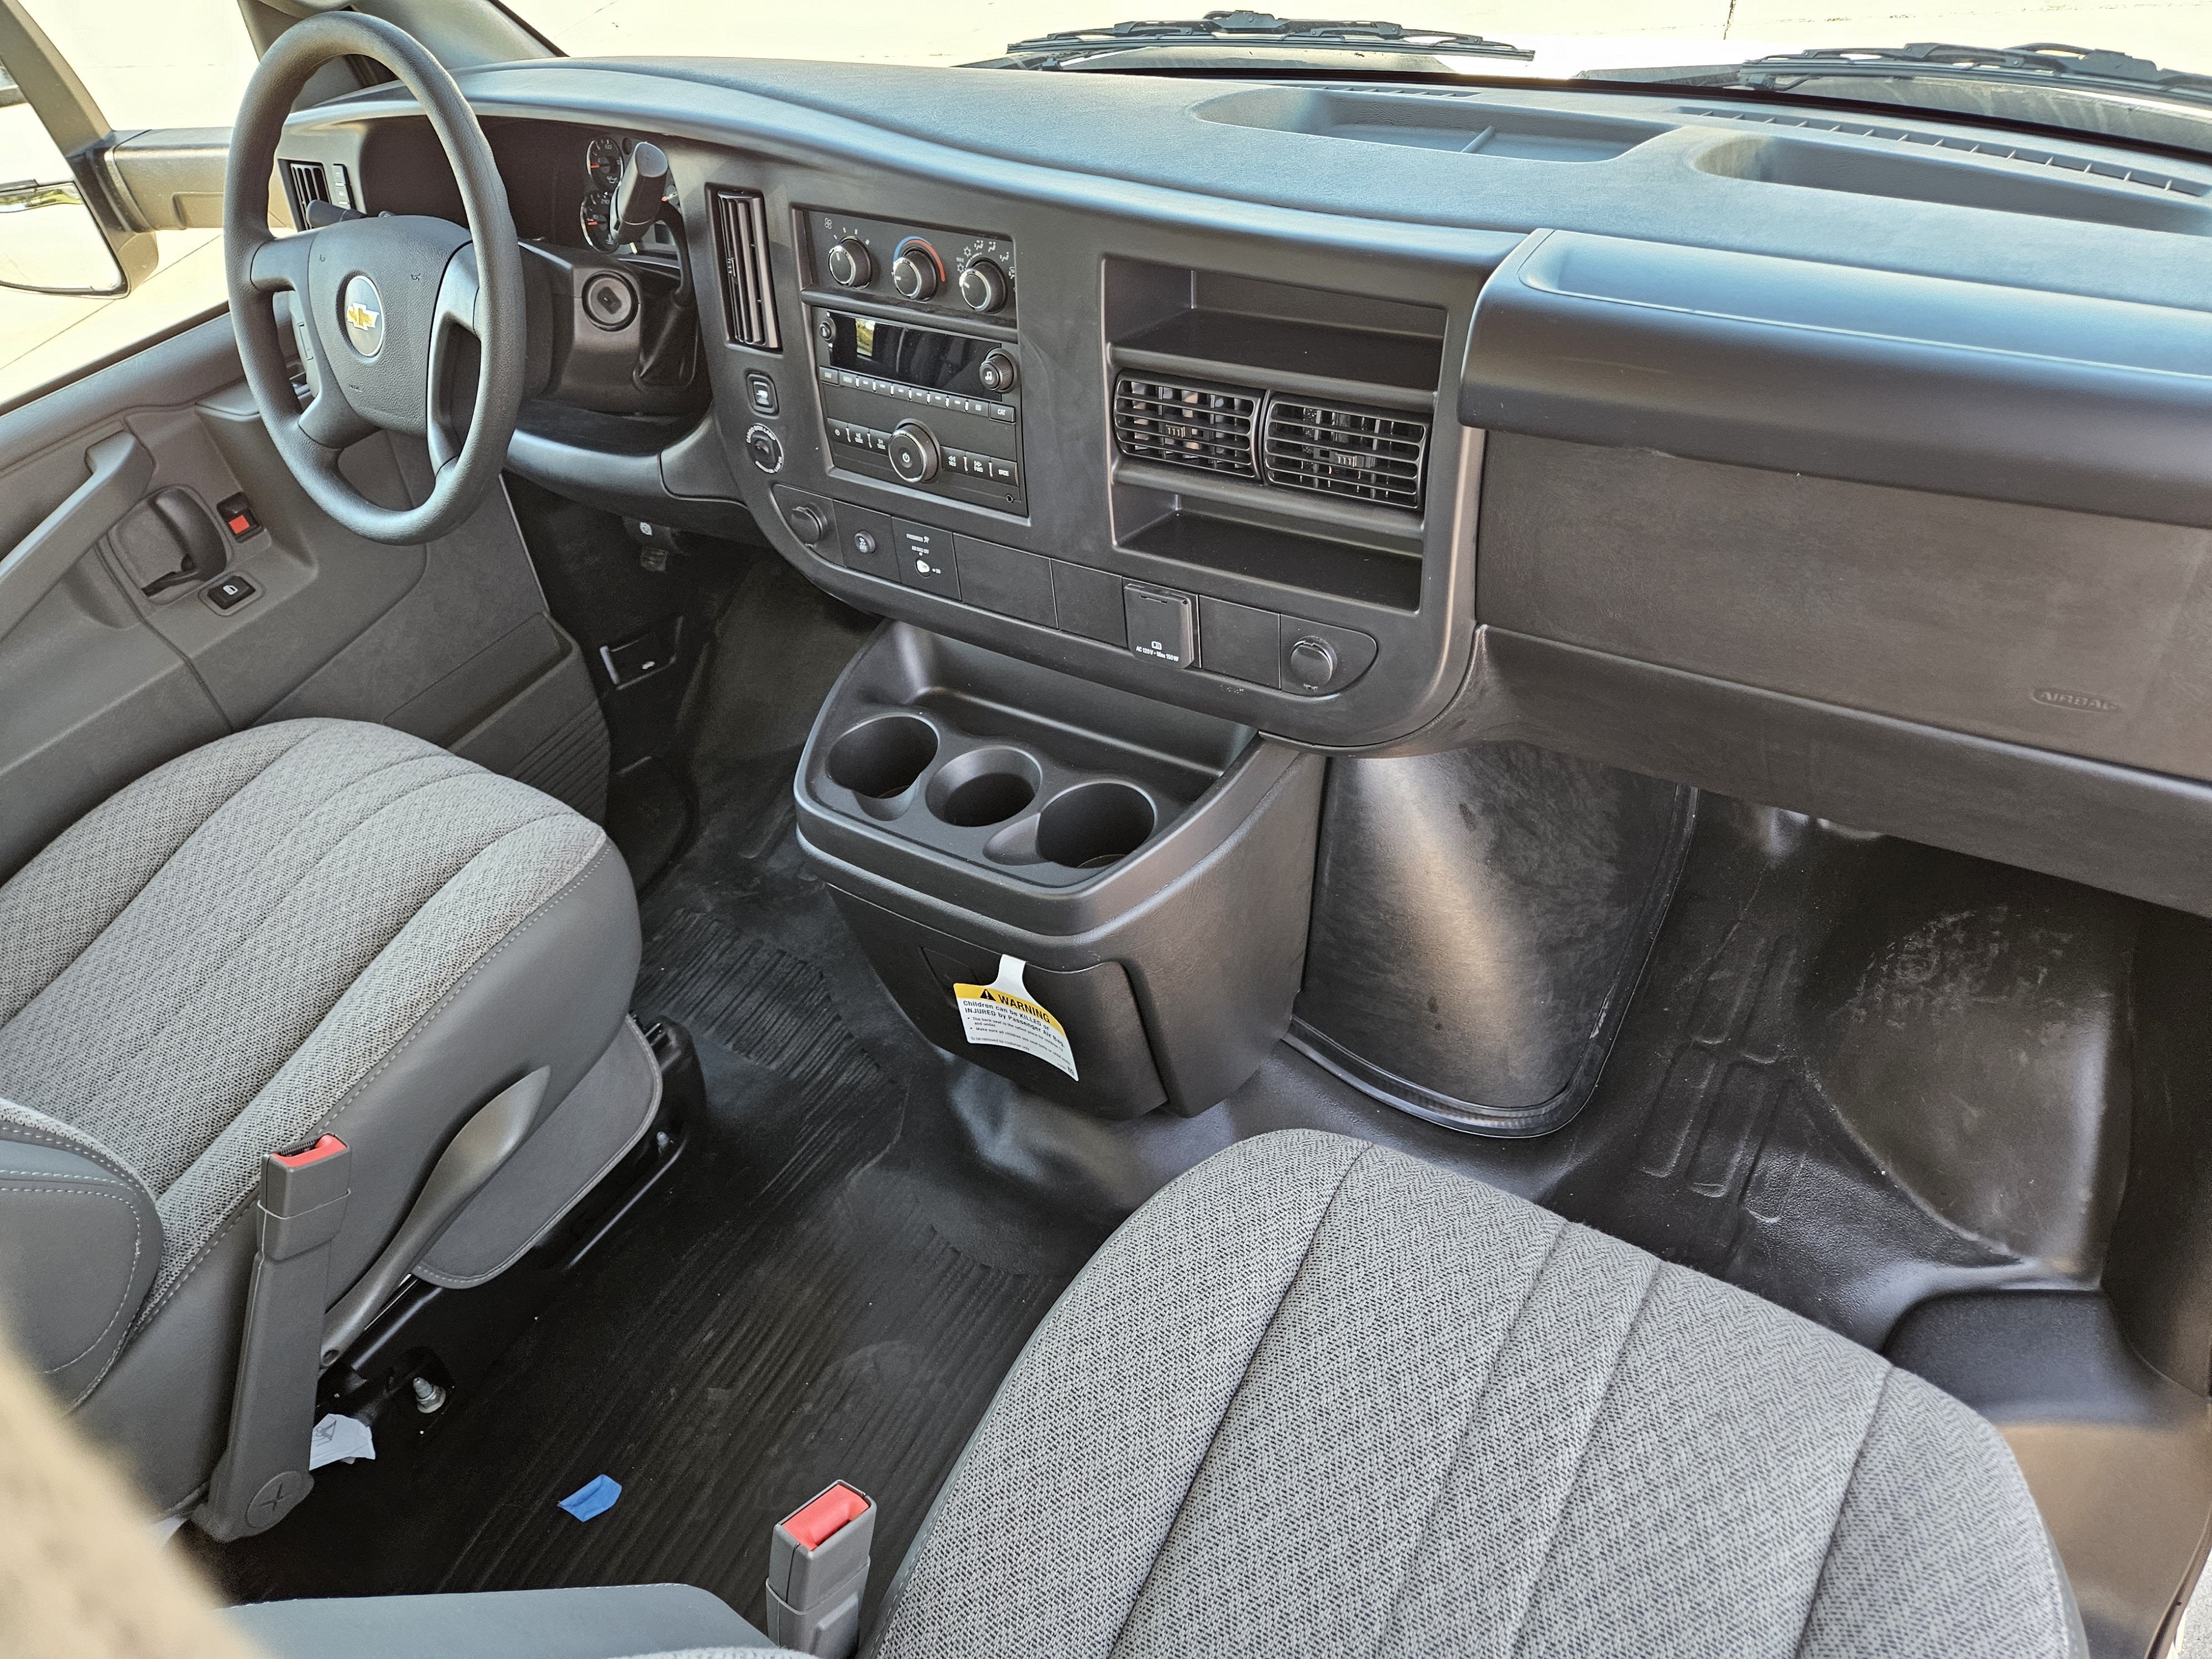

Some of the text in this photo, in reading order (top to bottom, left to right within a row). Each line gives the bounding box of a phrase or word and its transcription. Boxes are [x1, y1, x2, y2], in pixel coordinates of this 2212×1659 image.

[963, 1000, 994, 1009] Children
[1019, 1013, 1041, 1026] KILLED
[965, 1008, 996, 1016] INJURED
[1008, 1015, 1041, 1032] Passenger
[1043, 1030, 1051, 1038] Air
[998, 994, 1051, 1024] WARNING
